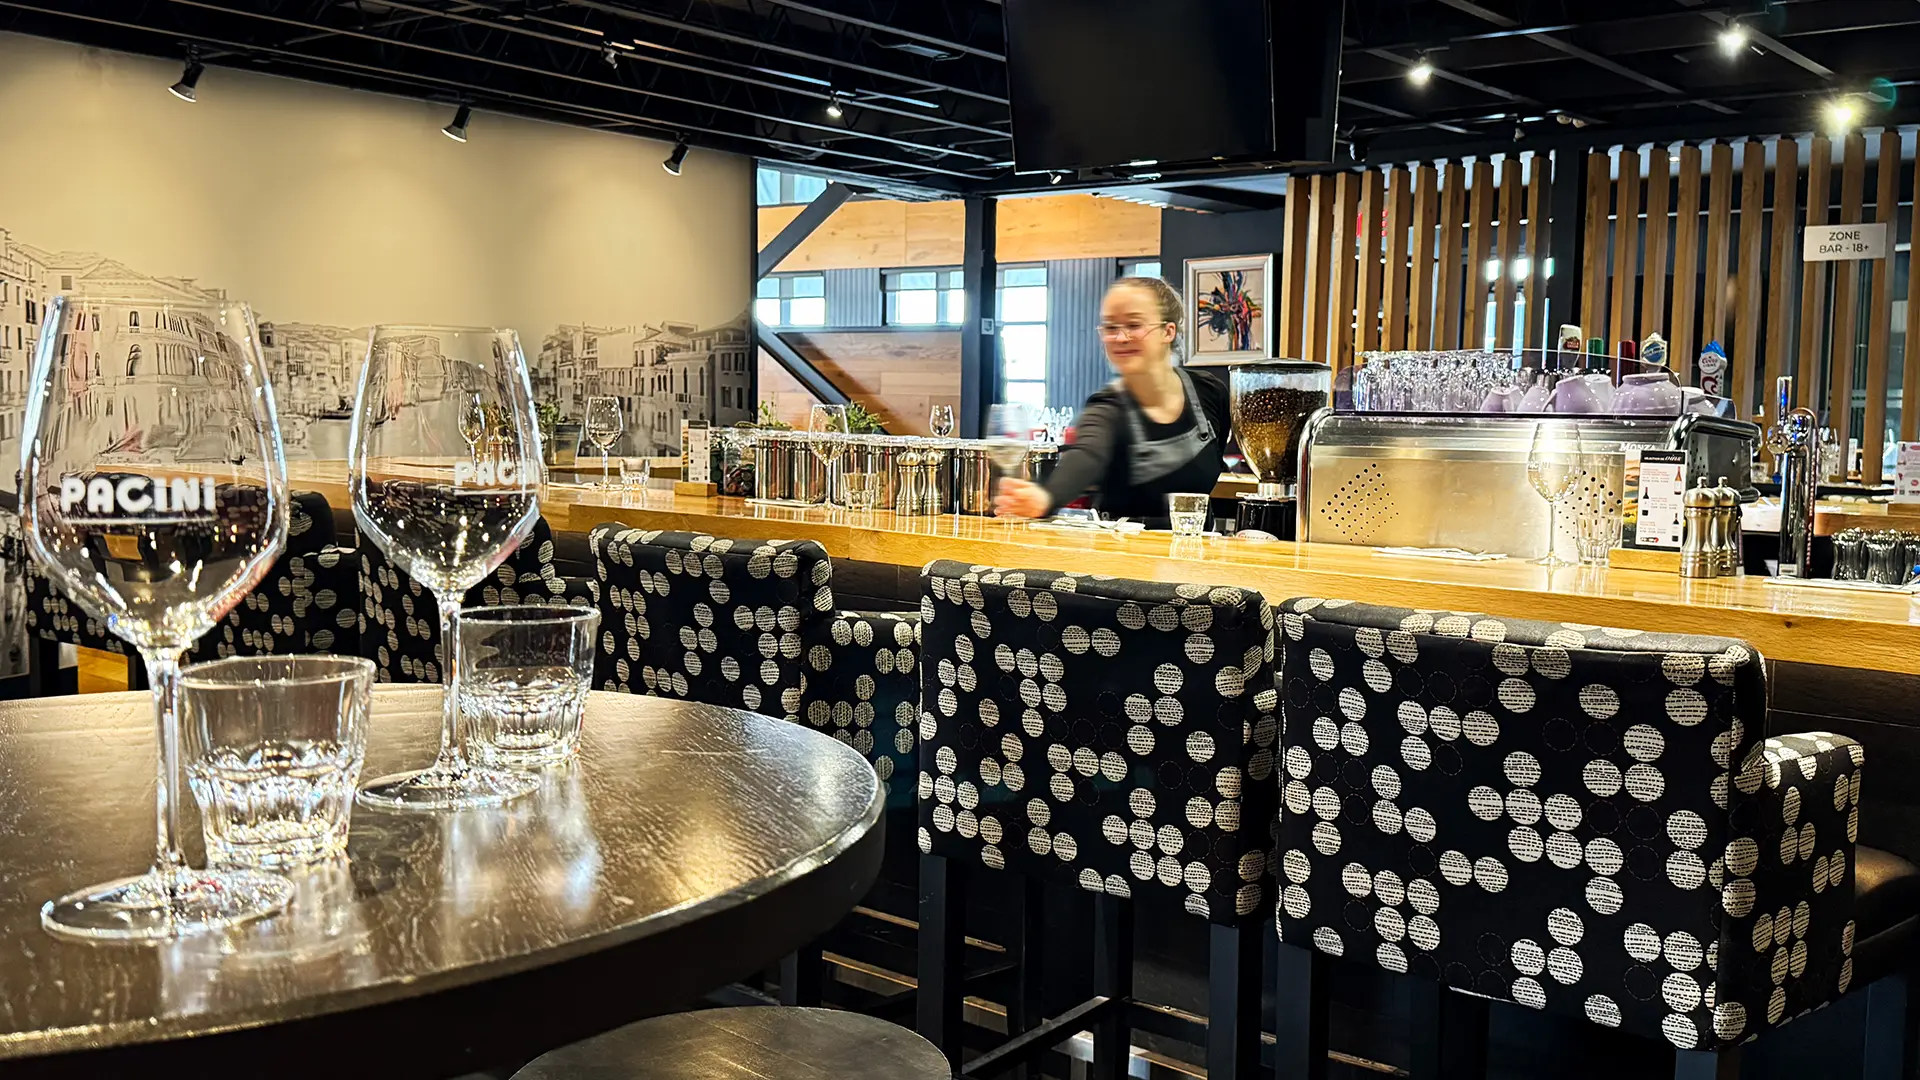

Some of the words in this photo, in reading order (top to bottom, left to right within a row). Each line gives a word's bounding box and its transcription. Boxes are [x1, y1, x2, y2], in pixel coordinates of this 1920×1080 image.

[1829, 231, 1860, 241] ZONE
[1819, 244, 1842, 253] BAR
[1852, 243, 1869, 252] 18+
[1619, 442, 1656, 451] MONZA
[61, 476, 216, 513] PACINI
